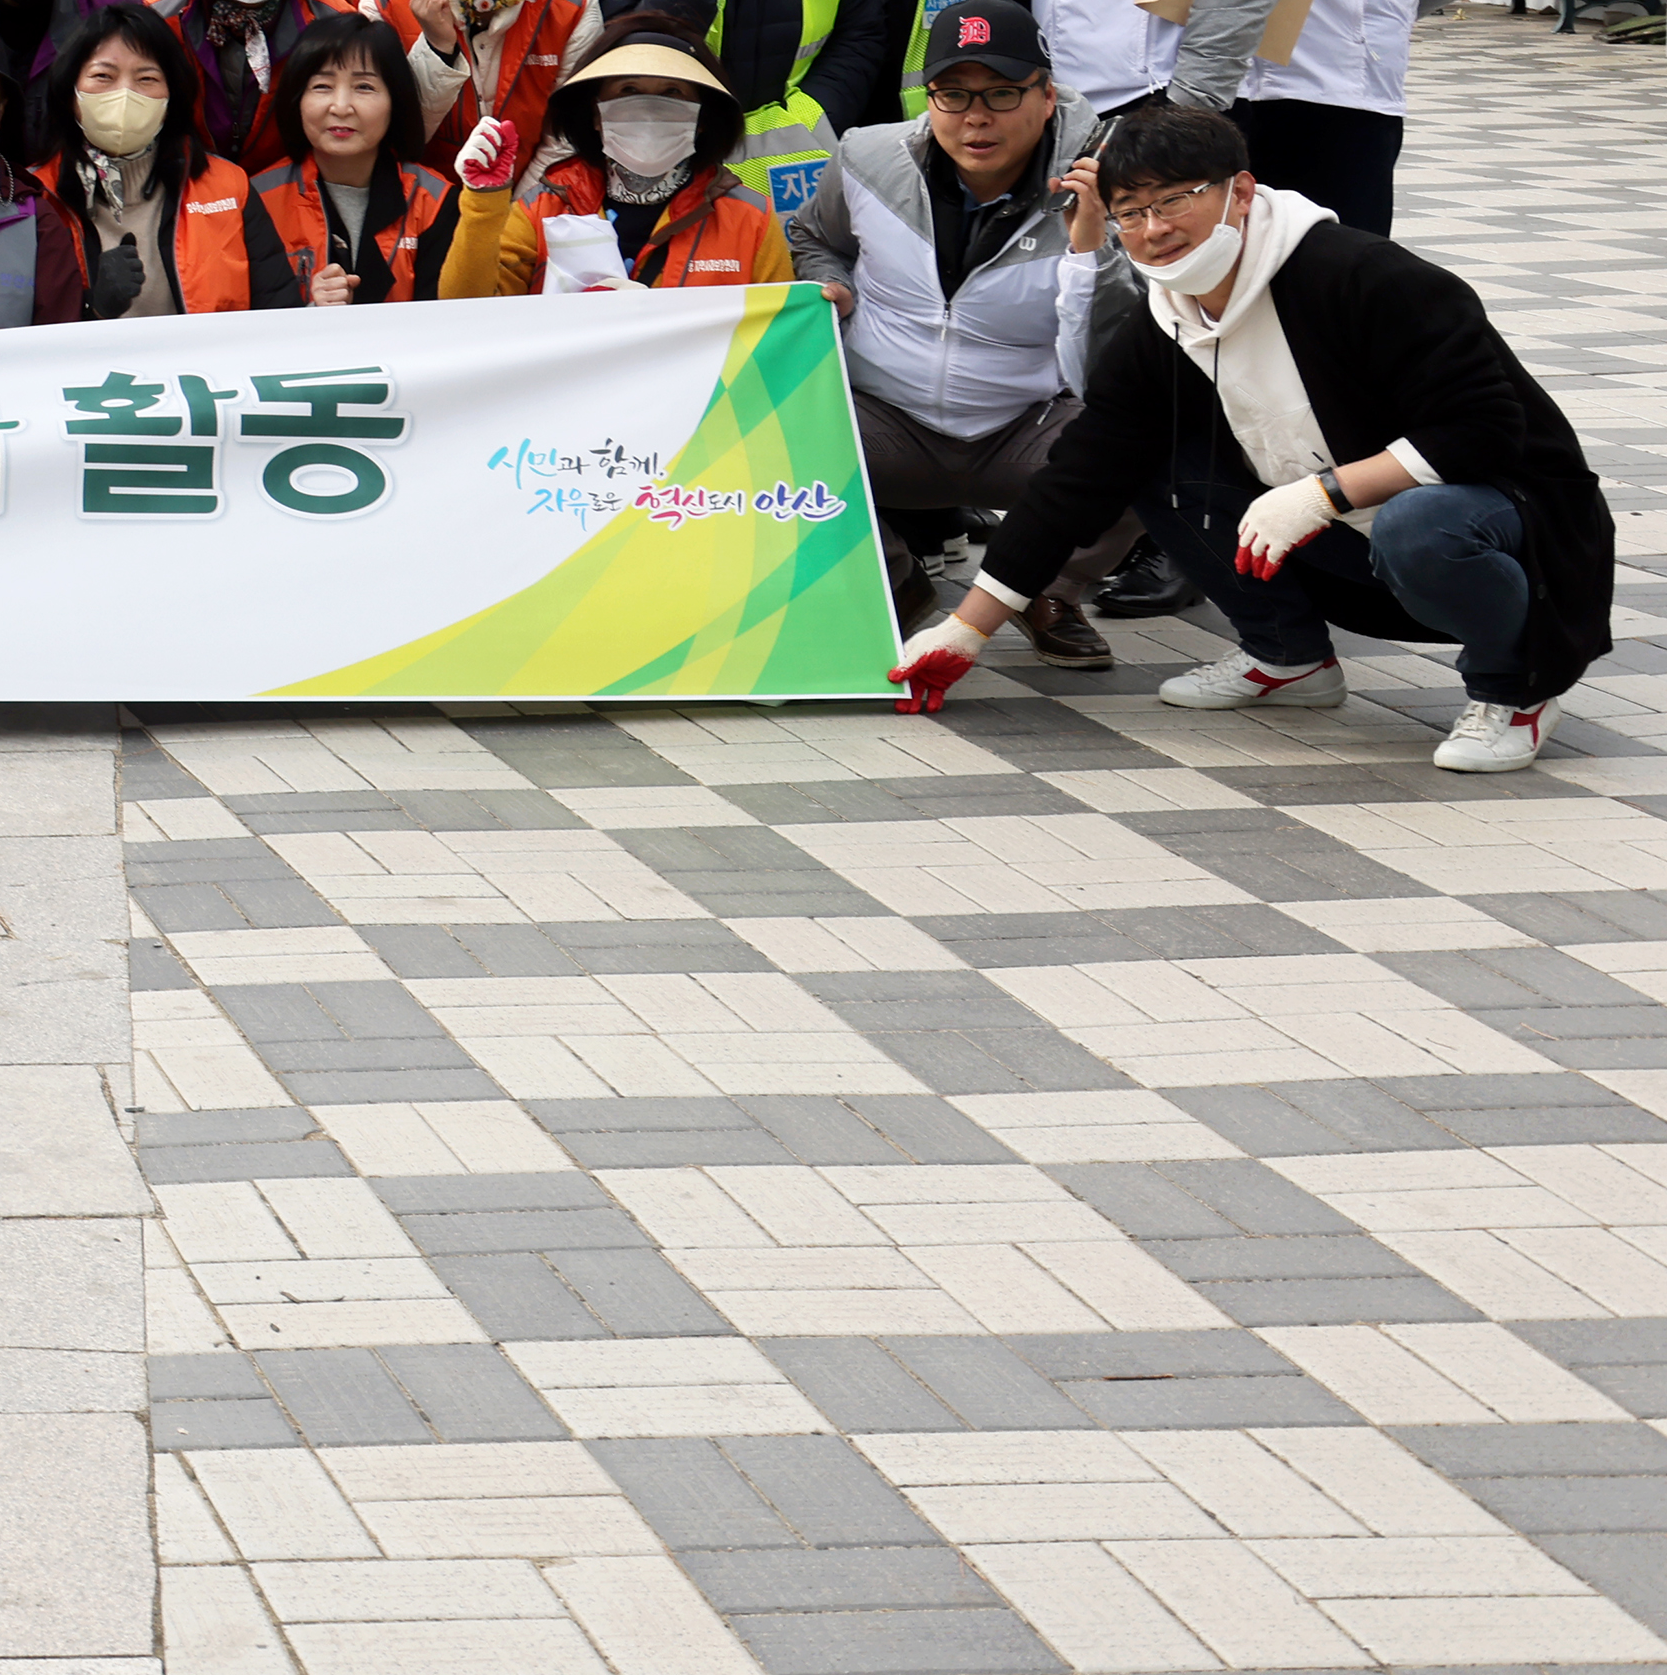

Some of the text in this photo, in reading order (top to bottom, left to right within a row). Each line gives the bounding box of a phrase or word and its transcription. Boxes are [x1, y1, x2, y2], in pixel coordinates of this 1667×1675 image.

[61, 363, 410, 517] 활동
[487, 438, 591, 490] 시민과
[526, 481, 848, 532] 자유로운 혁신도시 안산
